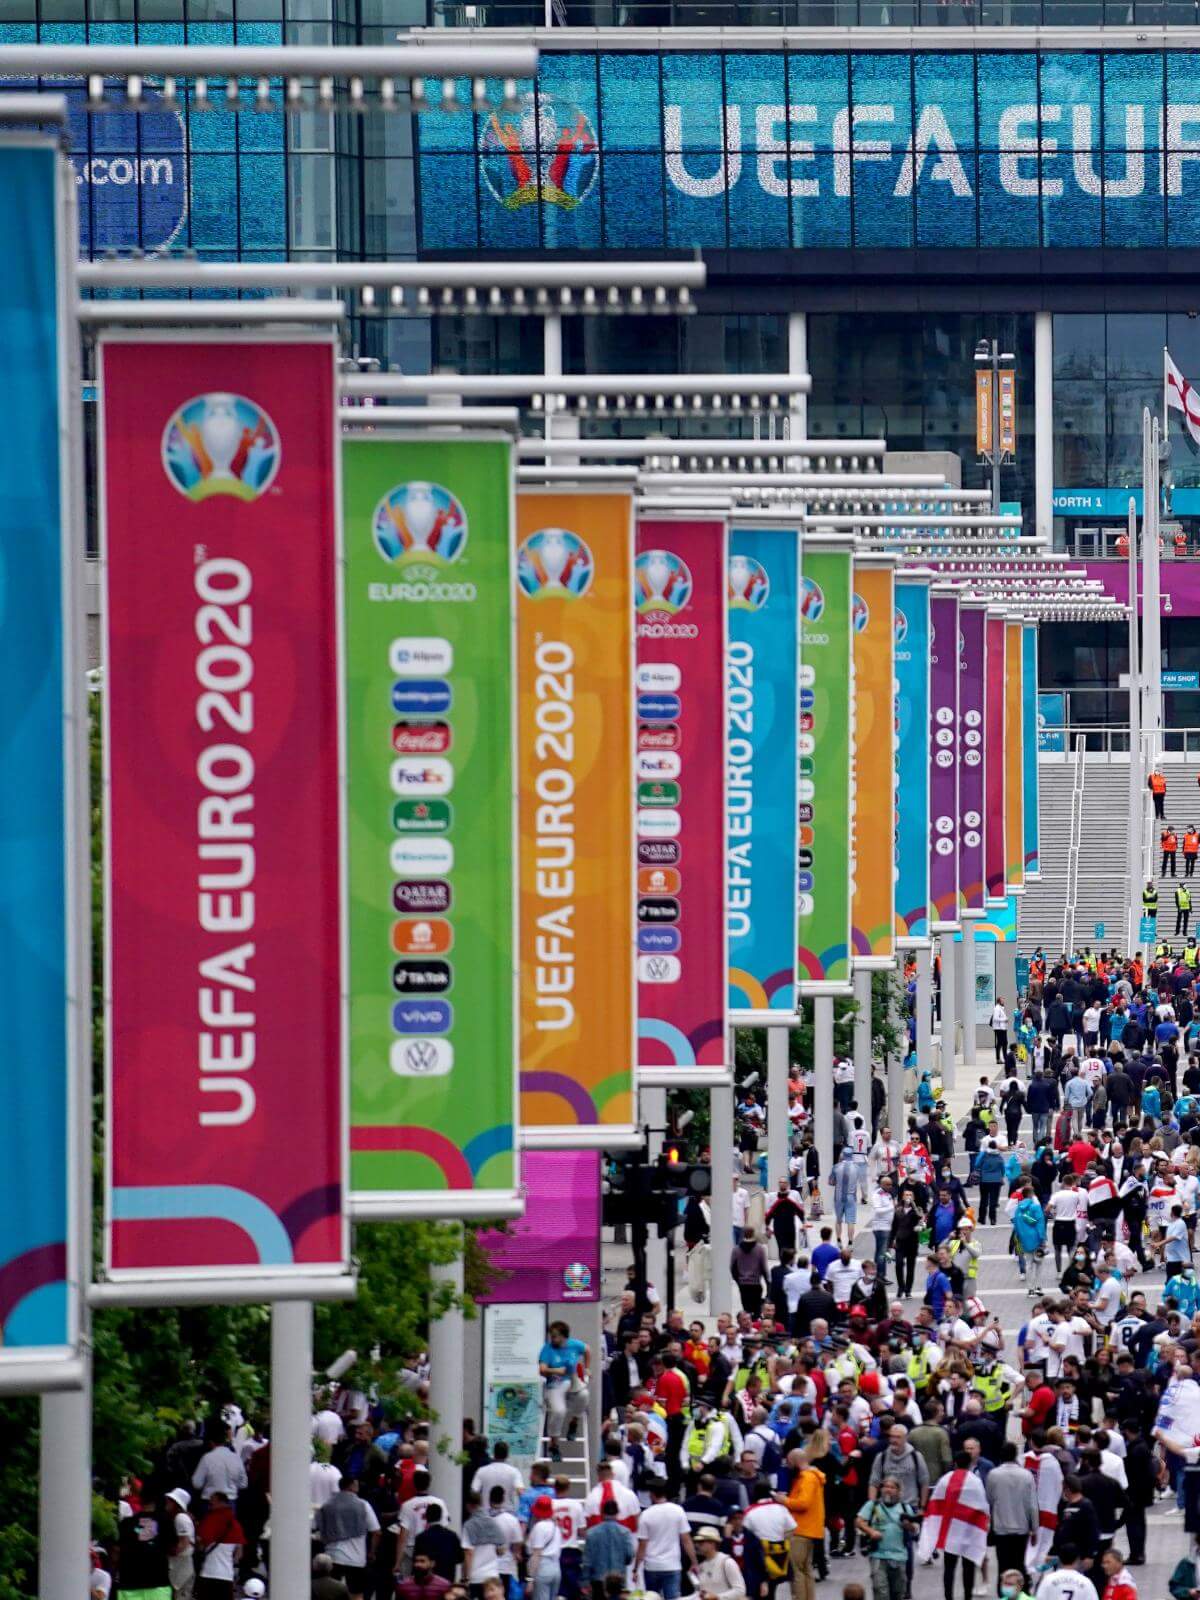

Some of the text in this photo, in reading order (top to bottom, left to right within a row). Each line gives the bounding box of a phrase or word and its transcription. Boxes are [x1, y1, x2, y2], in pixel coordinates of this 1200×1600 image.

[663, 104, 974, 198] UEFA
[1051, 497, 1102, 508] NORTH 1
[368, 582, 477, 601] EURO2020
[194, 556, 254, 733] 2020
[535, 639, 575, 762] 2020
[942, 711, 948, 721] 1
[970, 713, 976, 723] 1
[941, 732, 948, 742] 3
[969, 733, 976, 743] 3
[937, 754, 952, 763] CW
[966, 753, 980, 762] CW
[398, 768, 444, 783] FedEx
[727, 641, 754, 938] UEFA EURO 2020
[941, 820, 948, 830] 2
[969, 815, 976, 824] 2
[196, 743, 256, 933] EURO
[535, 767, 576, 902] EURO
[968, 834, 976, 844] 4
[940, 841, 949, 852] 4
[535, 903, 576, 1032] UEFA
[401, 1012, 443, 1023] vivo
[198, 943, 256, 1128] UEFA
[1088, 1062, 1099, 1071] 19
